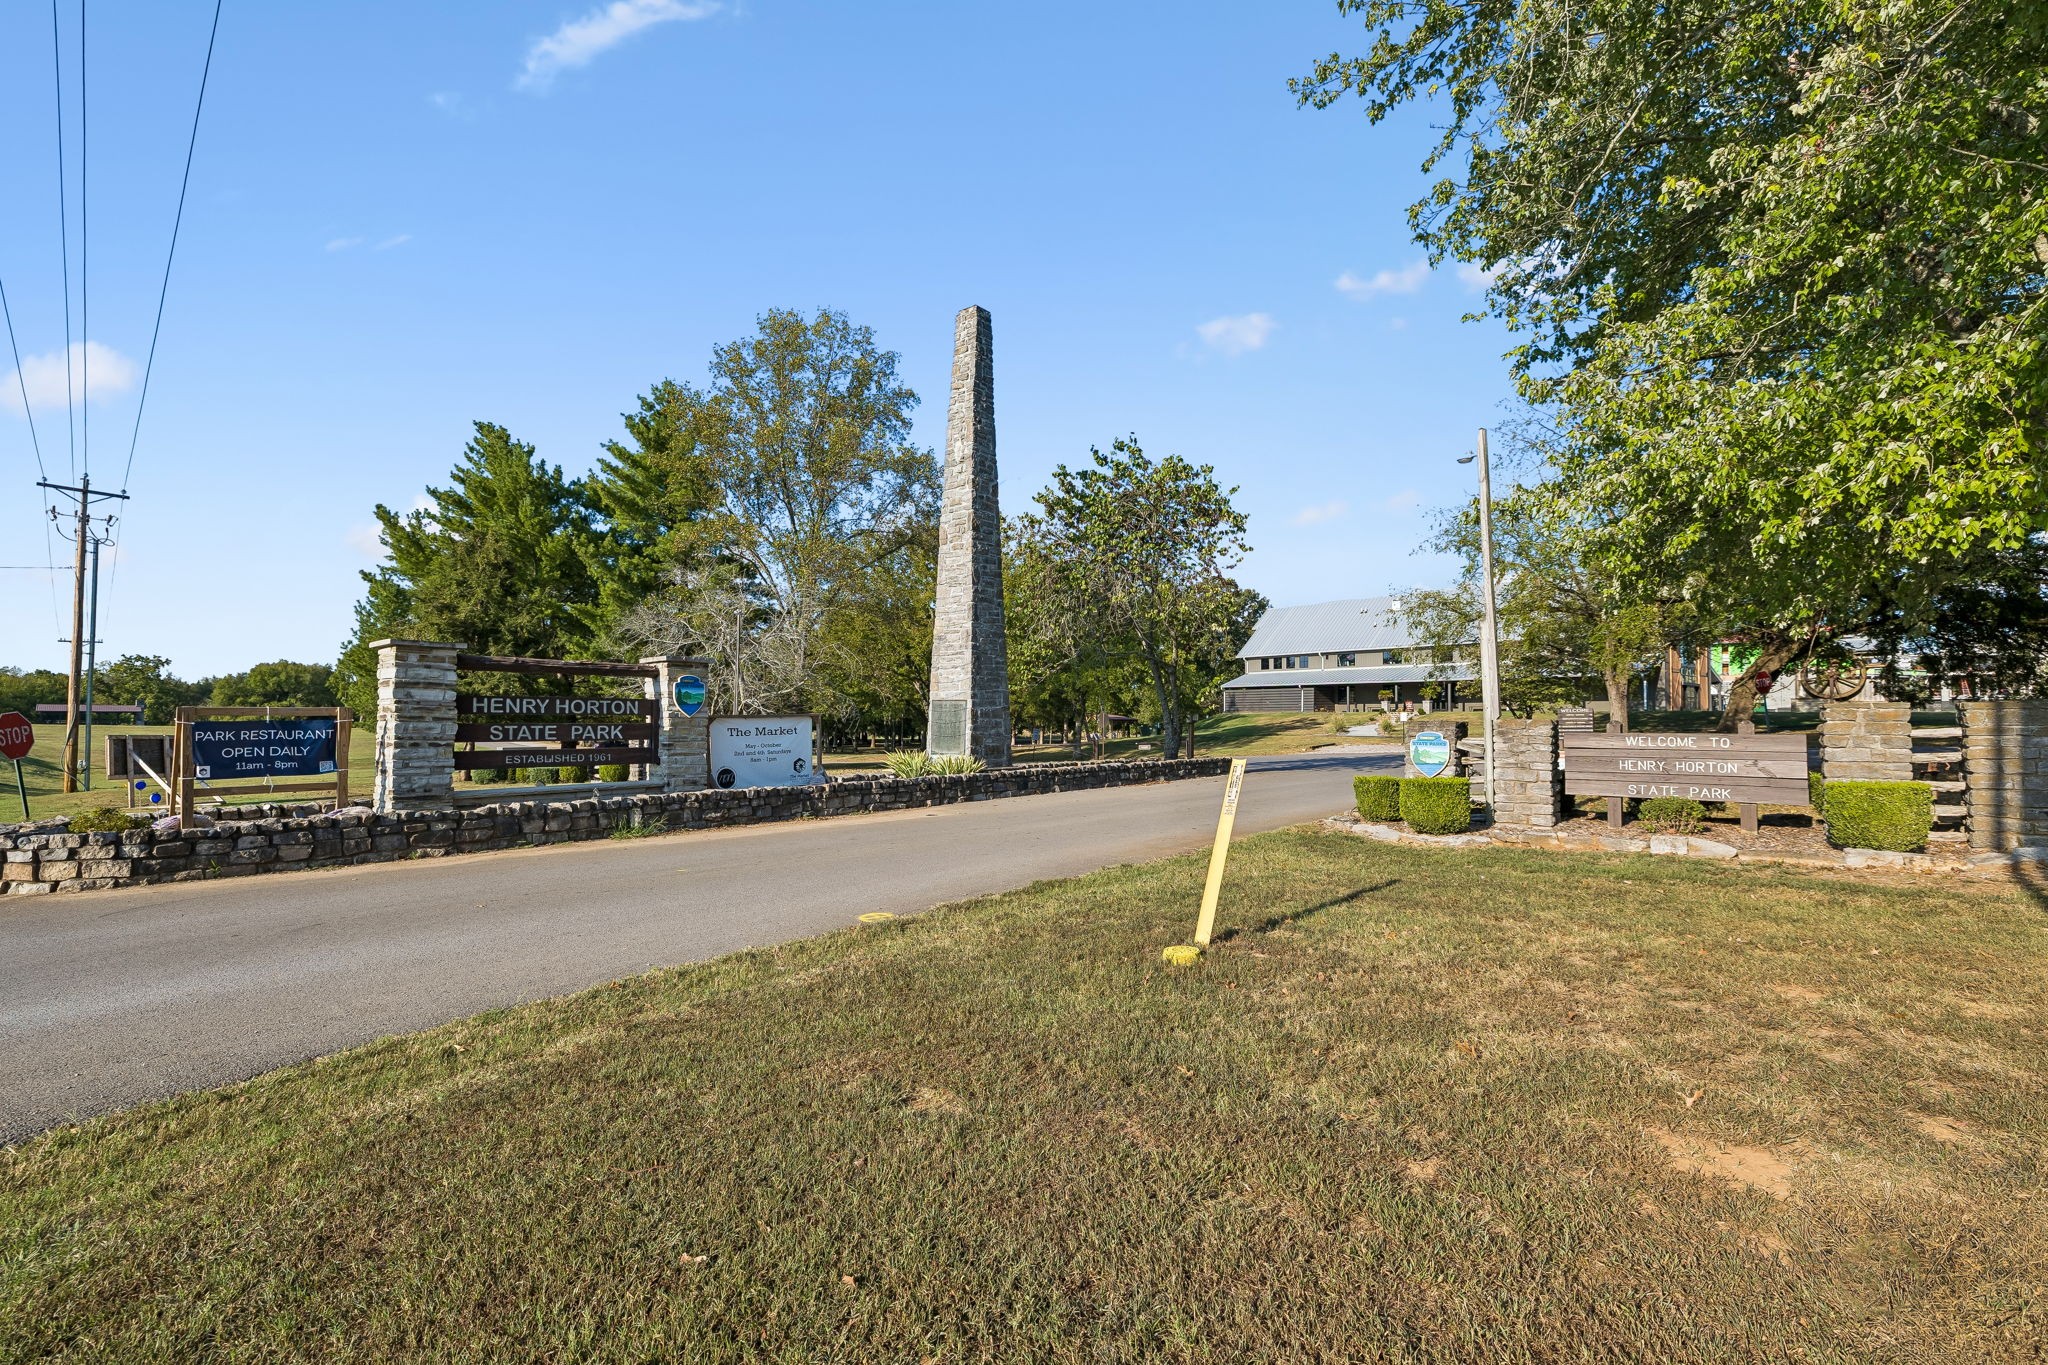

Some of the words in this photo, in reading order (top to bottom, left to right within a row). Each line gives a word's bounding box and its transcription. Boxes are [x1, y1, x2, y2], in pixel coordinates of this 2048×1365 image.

[472, 698, 550, 714] HENRY
[555, 700, 639, 714] HORTON
[0, 725, 30, 747] STOP
[195, 731, 236, 741] PARK
[240, 730, 334, 740] RESTAURANT
[489, 725, 557, 741] STATE
[571, 725, 623, 740] PARK
[727, 727, 751, 736] The
[755, 726, 797, 736] Market
[1625, 736, 1697, 748] WELCOME
[1709, 737, 1730, 748] TO
[221, 747, 265, 758] OPEN
[269, 746, 310, 756] DAILY
[505, 754, 585, 764] ESTABLISHED
[589, 753, 612, 762] 1961
[235, 761, 264, 770] 11am
[274, 760, 299, 769] 8pm
[1619, 760, 1666, 772] HENRY
[1675, 761, 1738, 774] HORTON
[1628, 784, 1679, 797] STATE
[1689, 786, 1731, 799] PARK
